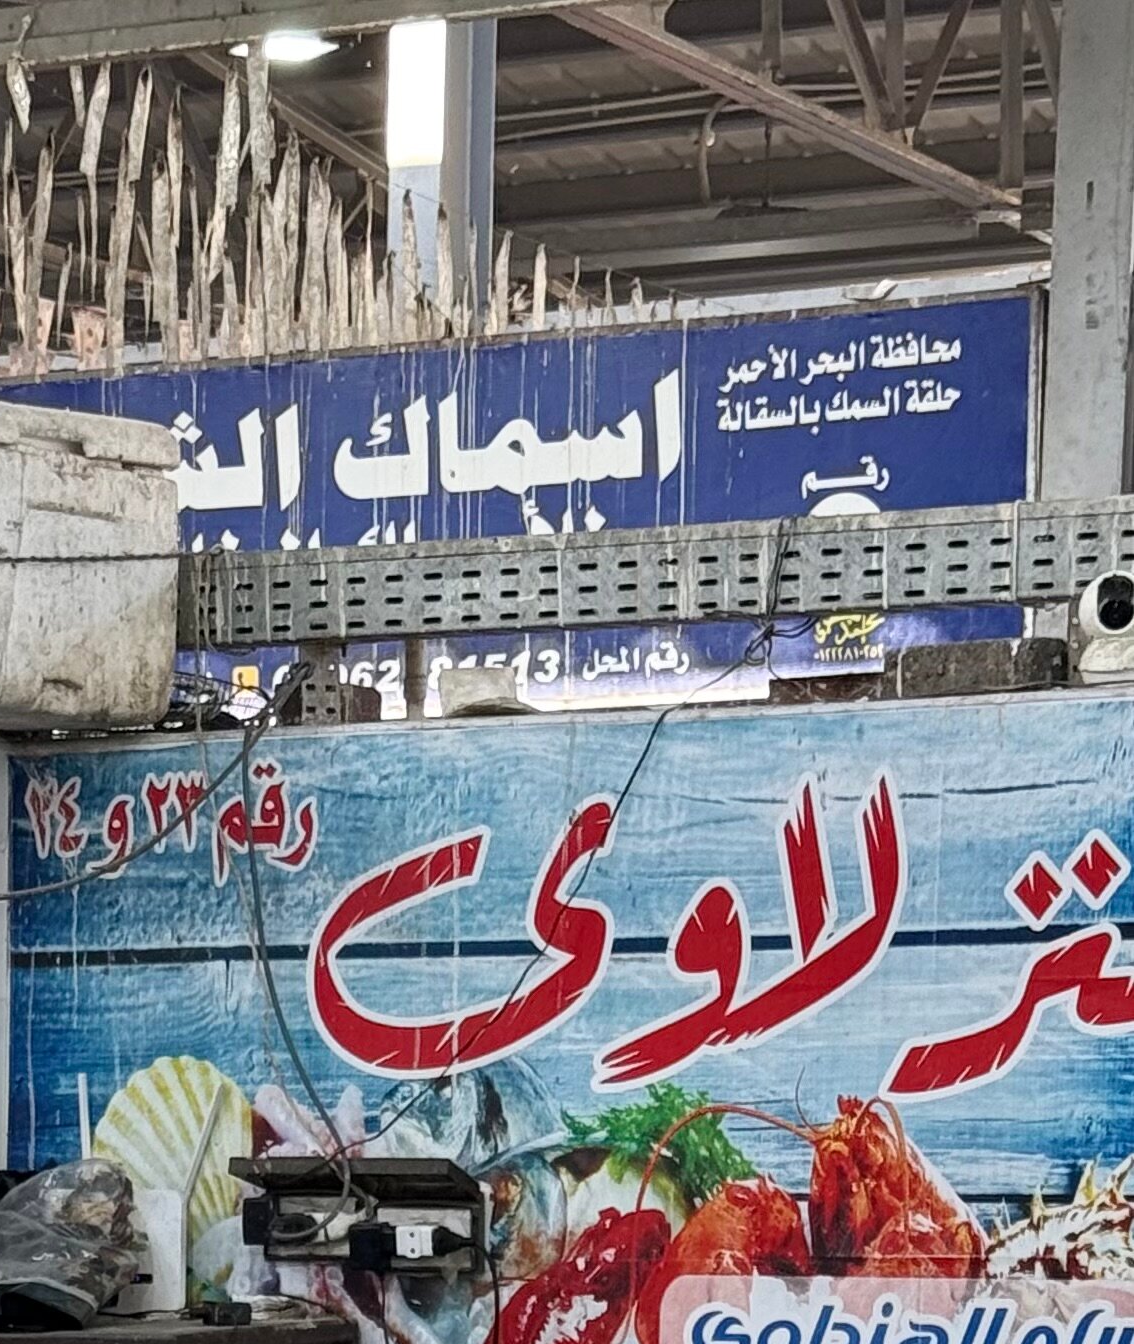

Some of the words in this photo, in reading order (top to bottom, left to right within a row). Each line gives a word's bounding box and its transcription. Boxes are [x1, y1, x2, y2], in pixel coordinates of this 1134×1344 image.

[718, 343, 797, 393] الأحمر
[799, 340, 865, 385] البحر
[870, 331, 961, 369] محافظة
[716, 394, 822, 435] بالسقالة
[824, 384, 900, 421] السمك
[904, 379, 961, 414] حلقة
[334, 368, 680, 500] اسماك
[800, 455, 890, 499] رقم
[582, 644, 640, 681] المحل
[644, 641, 690, 679] رقم
[145, 773, 207, 852] ٢٣
[214, 763, 315, 884] رقم
[89, 799, 131, 874] و
[885, 837, 1134, 1094] تر
